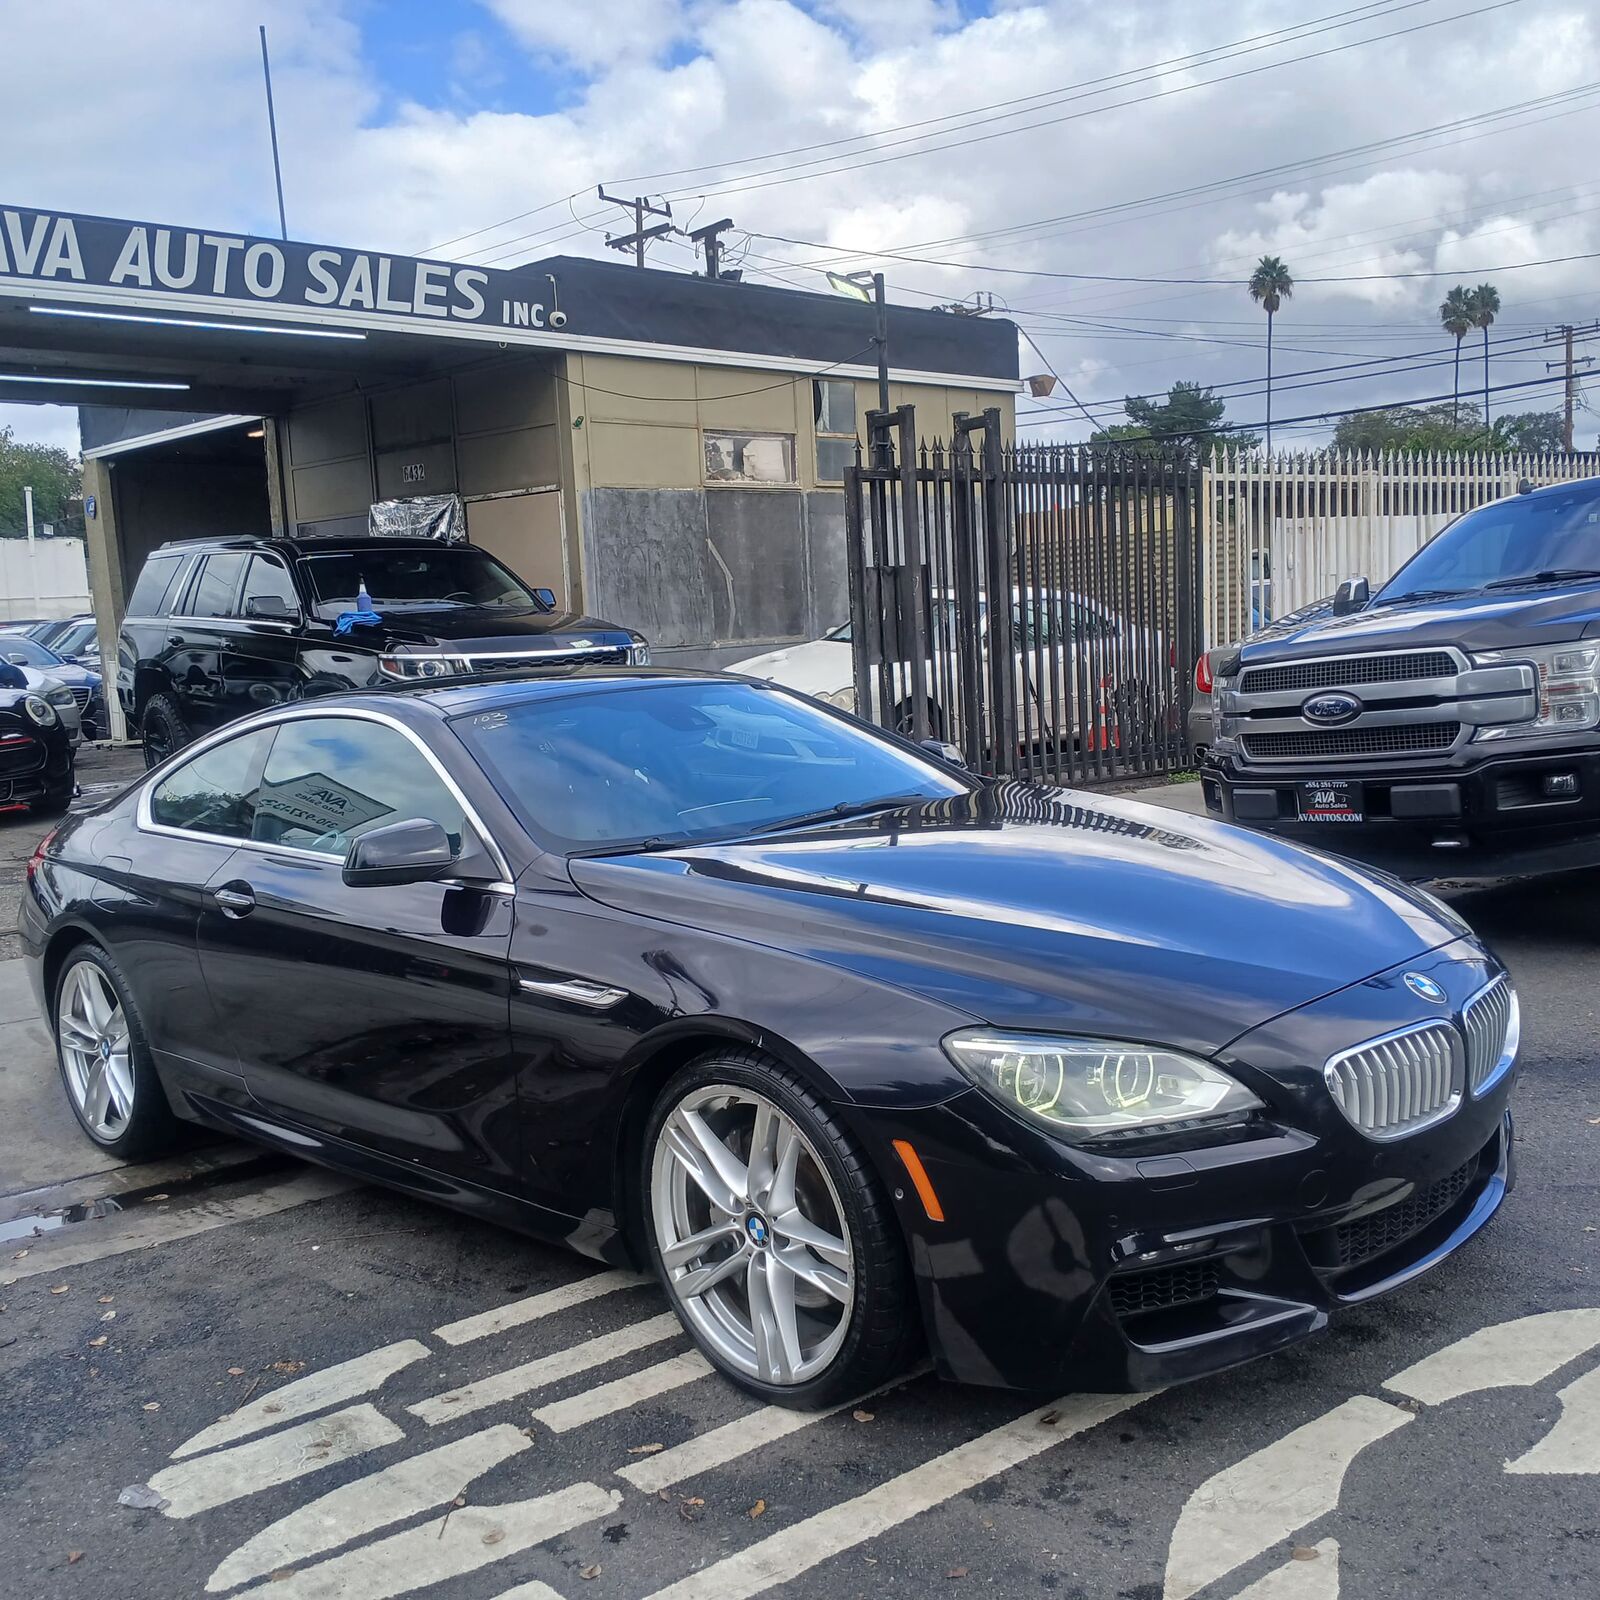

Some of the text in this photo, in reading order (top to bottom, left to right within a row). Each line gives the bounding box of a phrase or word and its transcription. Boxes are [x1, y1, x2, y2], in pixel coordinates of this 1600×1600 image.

[0, 211, 544, 328] VA AUTO SALES INC
[403, 464, 424, 481] 6432
[1315, 700, 1343, 715] Ford
[1314, 791, 1336, 803] AVA
[1298, 813, 1363, 822] AVAAUTOS.COM
